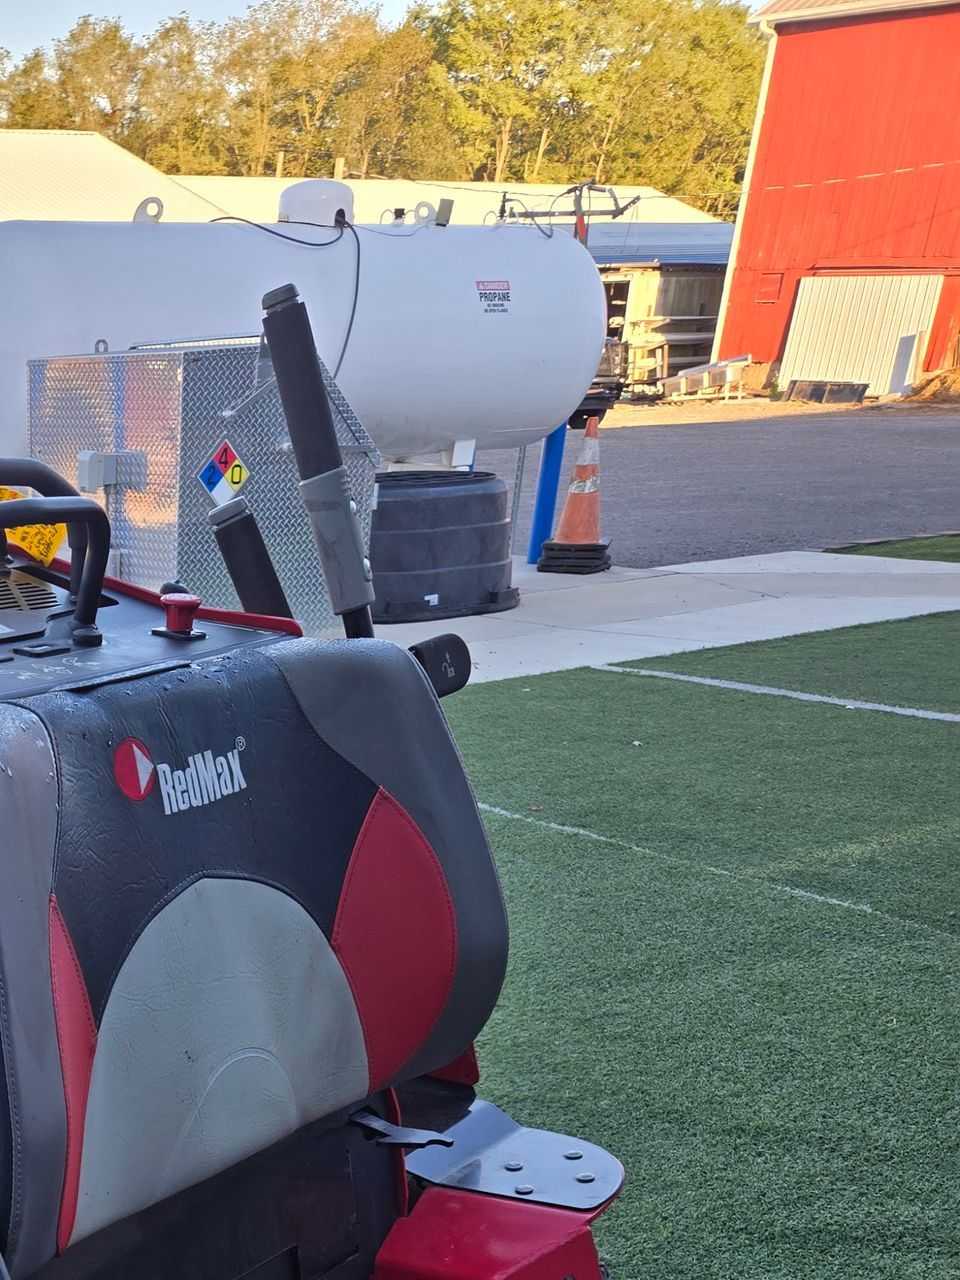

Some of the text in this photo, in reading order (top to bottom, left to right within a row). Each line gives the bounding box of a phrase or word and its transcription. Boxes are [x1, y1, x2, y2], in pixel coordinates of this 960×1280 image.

[479, 292, 511, 302] PROPANE
[219, 447, 229, 469] 4
[207, 464, 217, 486] 2
[231, 464, 243, 485] 0
